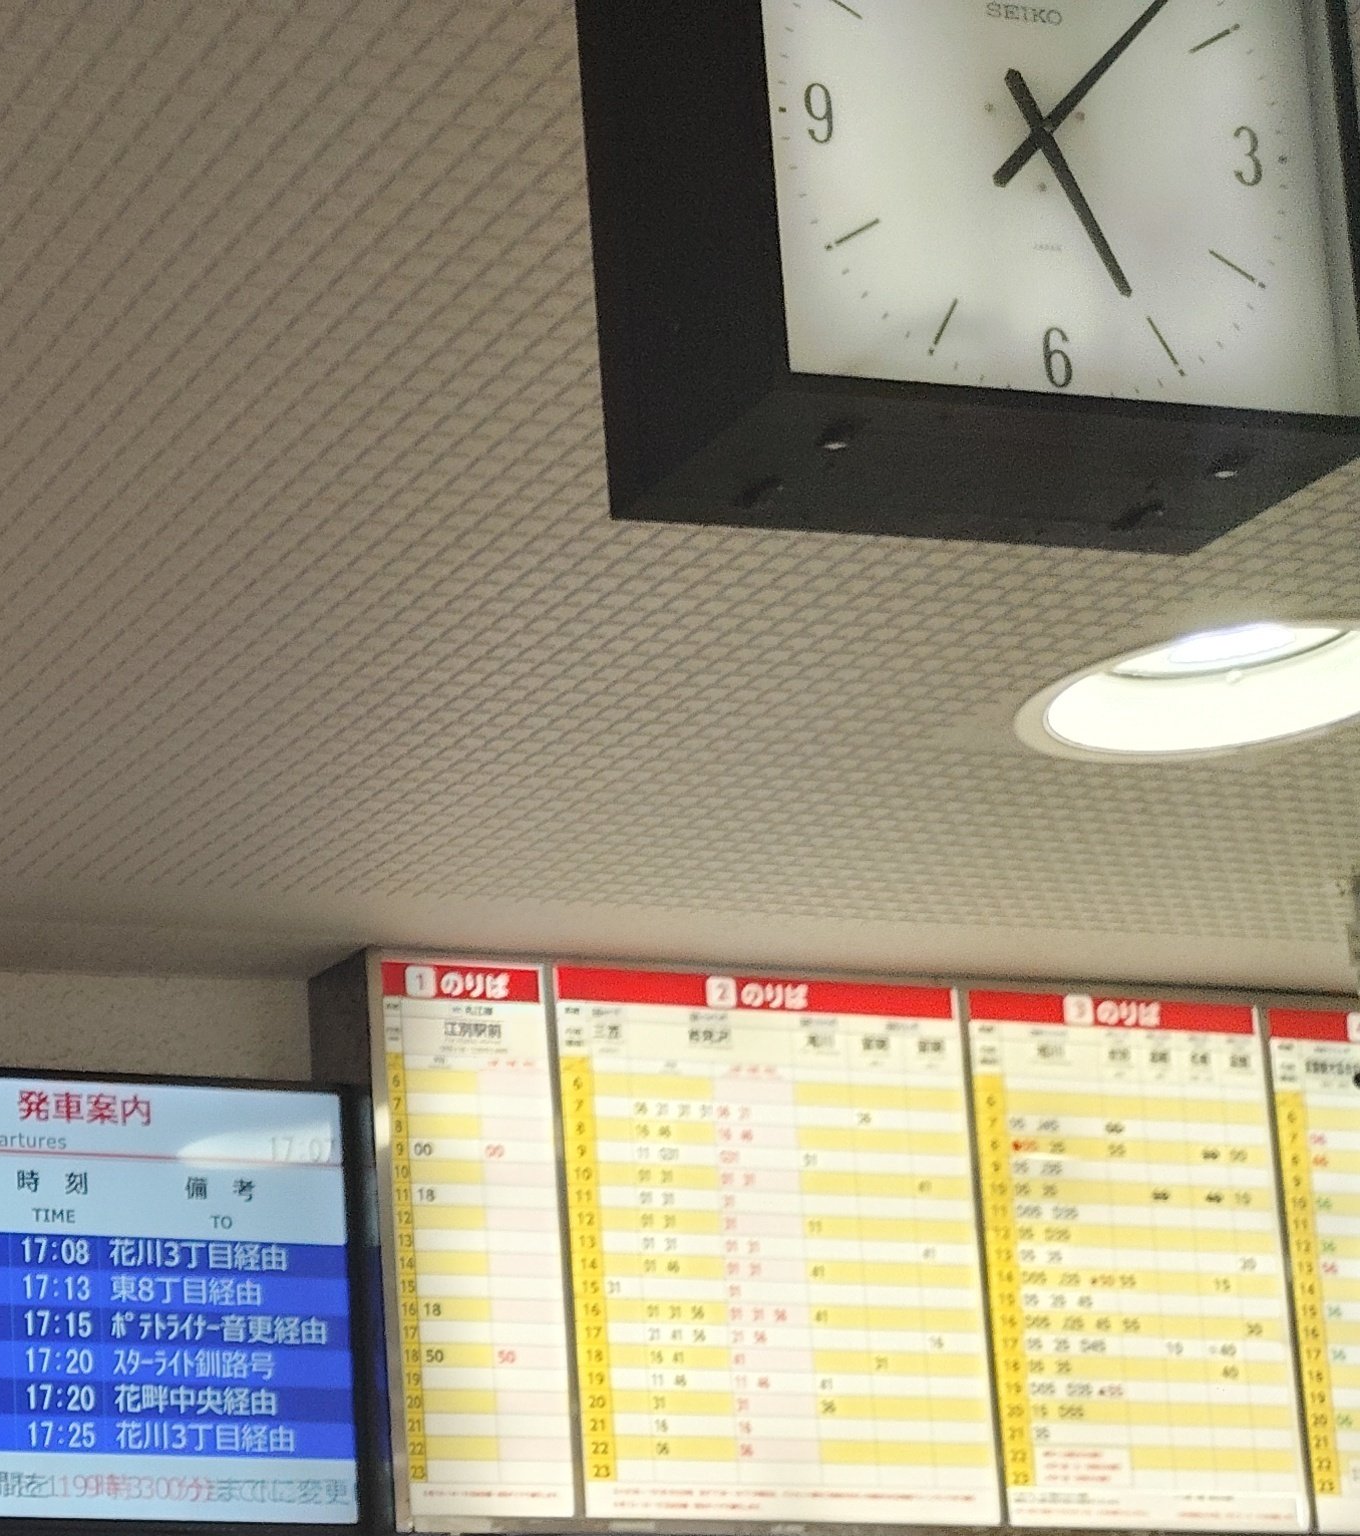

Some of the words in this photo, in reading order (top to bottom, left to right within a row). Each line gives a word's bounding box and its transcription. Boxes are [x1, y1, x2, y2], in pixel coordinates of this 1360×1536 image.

[986, 5, 1063, 26] SEIKO
[803, 82, 834, 144] 9
[1234, 125, 1263, 186] 3
[1043, 327, 1074, 388] 6
[441, 972, 510, 998] のりば
[741, 984, 809, 1009] のりば
[1097, 1000, 1161, 1027] のりば
[19, 1090, 151, 1126] 発車案内
[415, 1143, 433, 1157] 00
[418, 1188, 435, 1202] 18
[22, 1237, 89, 1264] 17:08
[109, 1240, 288, 1272] 花川3丁目経由
[22, 1274, 91, 1301] 17:13
[110, 1276, 262, 1307] 東8丁目経由
[424, 1303, 441, 1317] 18
[24, 1311, 92, 1338] 17:15
[25, 1347, 93, 1375] 17:20
[426, 1350, 444, 1363] 50
[498, 1350, 516, 1364] 50
[27, 1385, 94, 1412] 17:20
[114, 1387, 277, 1416] 花畔中央経由
[27, 1421, 96, 1449] 17:25
[116, 1423, 295, 1452] 花川3丁目経由
